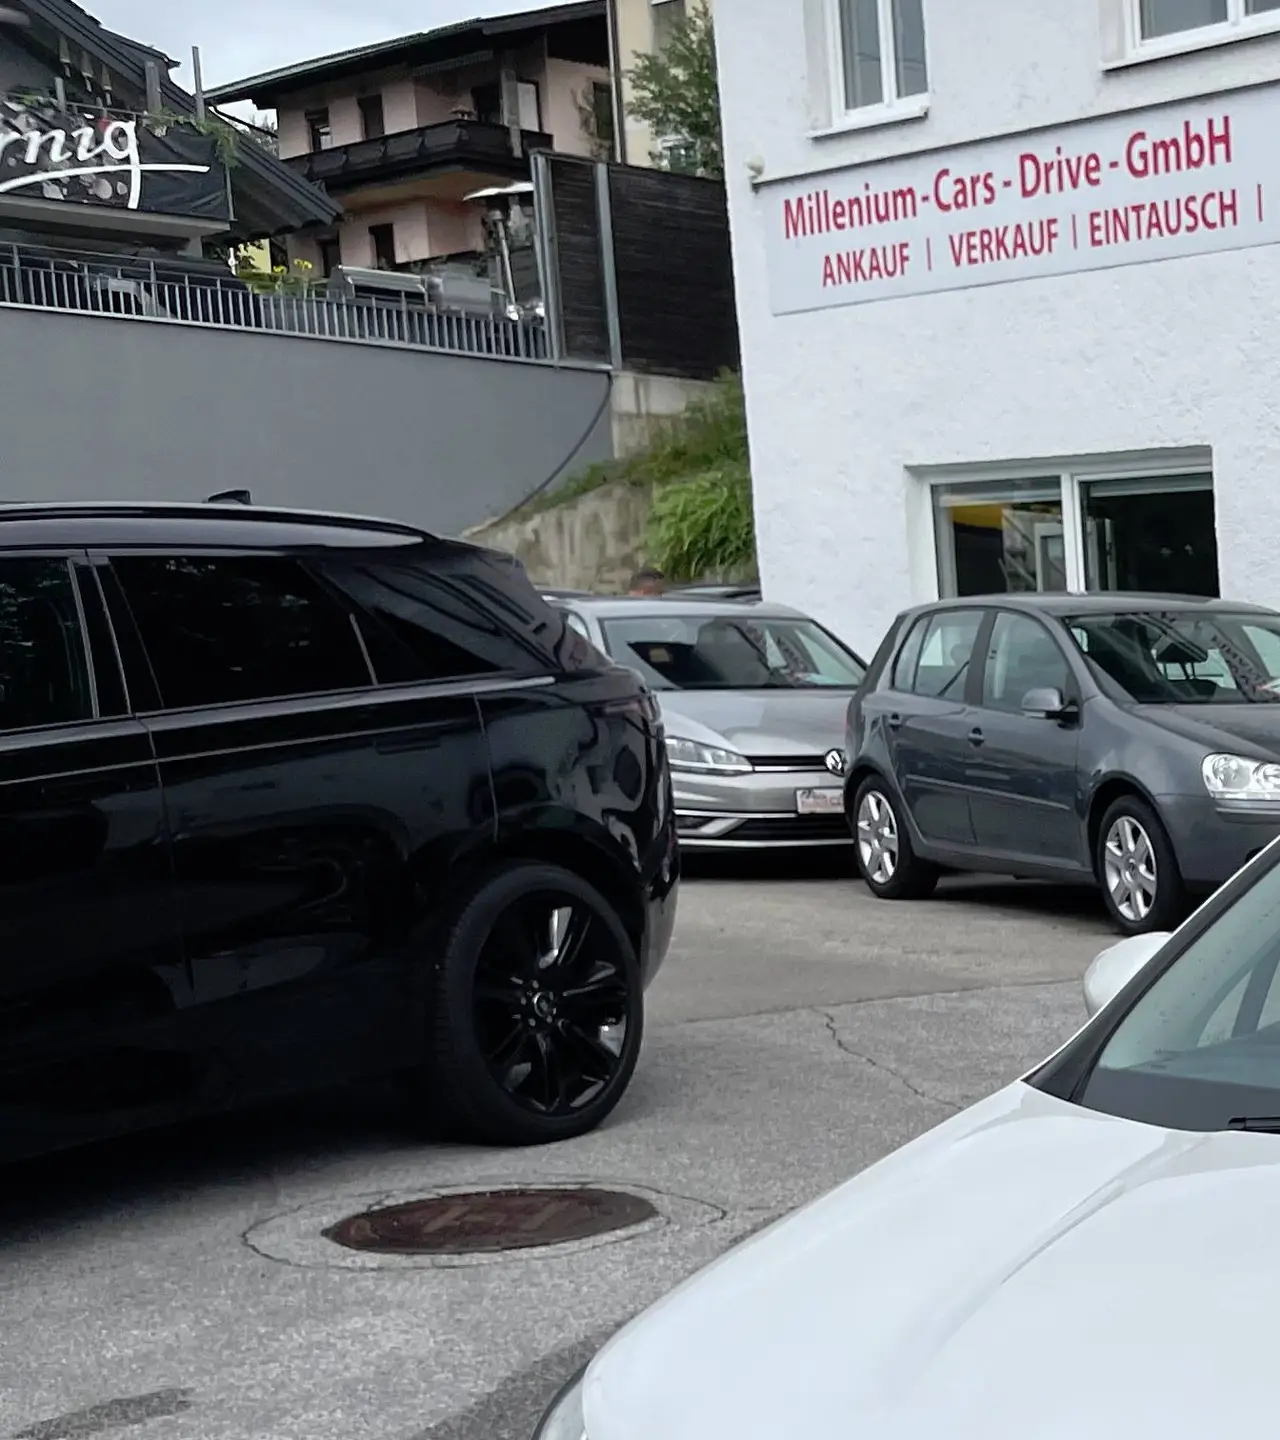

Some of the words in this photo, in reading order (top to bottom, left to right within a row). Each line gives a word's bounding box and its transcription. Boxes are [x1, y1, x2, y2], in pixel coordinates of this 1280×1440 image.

[822, 242, 910, 287] ANKAUF
[949, 217, 1059, 267] VERKAUF
[1089, 188, 1239, 248] EINTAUSCH
